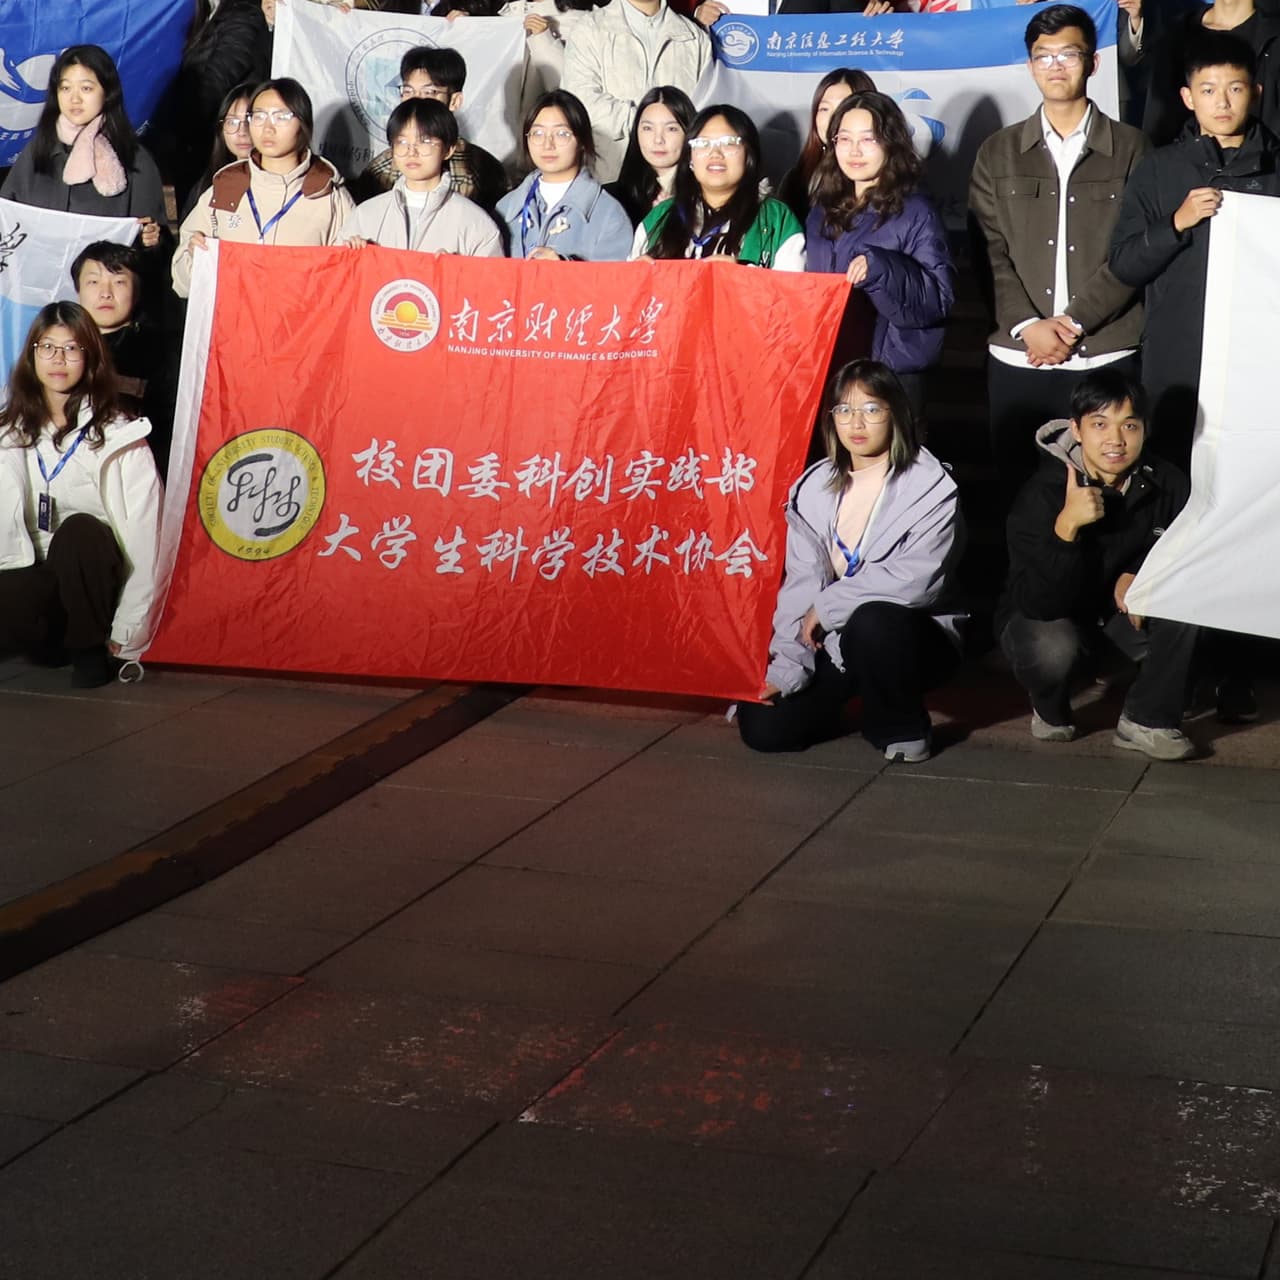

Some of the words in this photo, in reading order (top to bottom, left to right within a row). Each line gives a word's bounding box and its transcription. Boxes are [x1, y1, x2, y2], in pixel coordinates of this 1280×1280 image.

[448, 345, 488, 356] NANJING
[489, 348, 543, 359] UNIVERSITY
[544, 351, 557, 360] OF
[558, 351, 598, 361] FINANCE
[599, 352, 605, 361] &
[607, 349, 658, 361] ECONOMICS
[351, 437, 756, 509] 校团委科创实践部
[317, 514, 767, 582] 大学生科学技术协会
